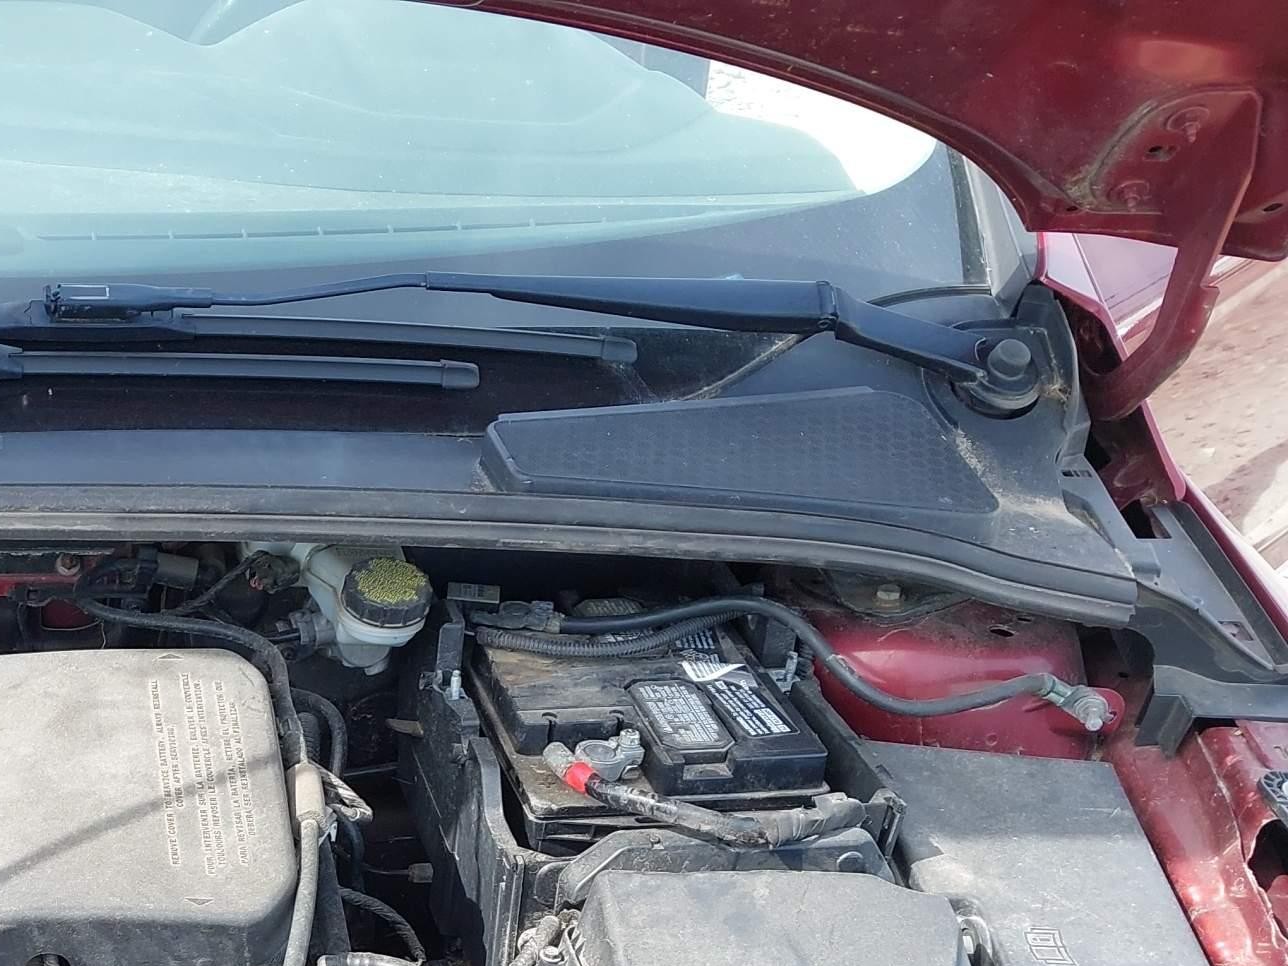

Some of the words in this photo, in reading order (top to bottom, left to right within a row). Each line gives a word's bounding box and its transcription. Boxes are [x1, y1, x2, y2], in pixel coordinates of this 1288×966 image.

[161, 769, 171, 798] SERVICE
[171, 764, 180, 783] AFTER
[174, 787, 183, 807] COVER
[197, 793, 206, 805] SUR
[166, 813, 176, 834] COVER
[209, 797, 220, 826] REPOSER
[199, 809, 211, 851] INTERVENIR
[233, 811, 245, 841] REVISAR
[169, 838, 180, 865] REMOVE
[213, 830, 225, 864] TOUJOURS
[239, 846, 248, 863] PARA
[206, 856, 215, 874] POUR
